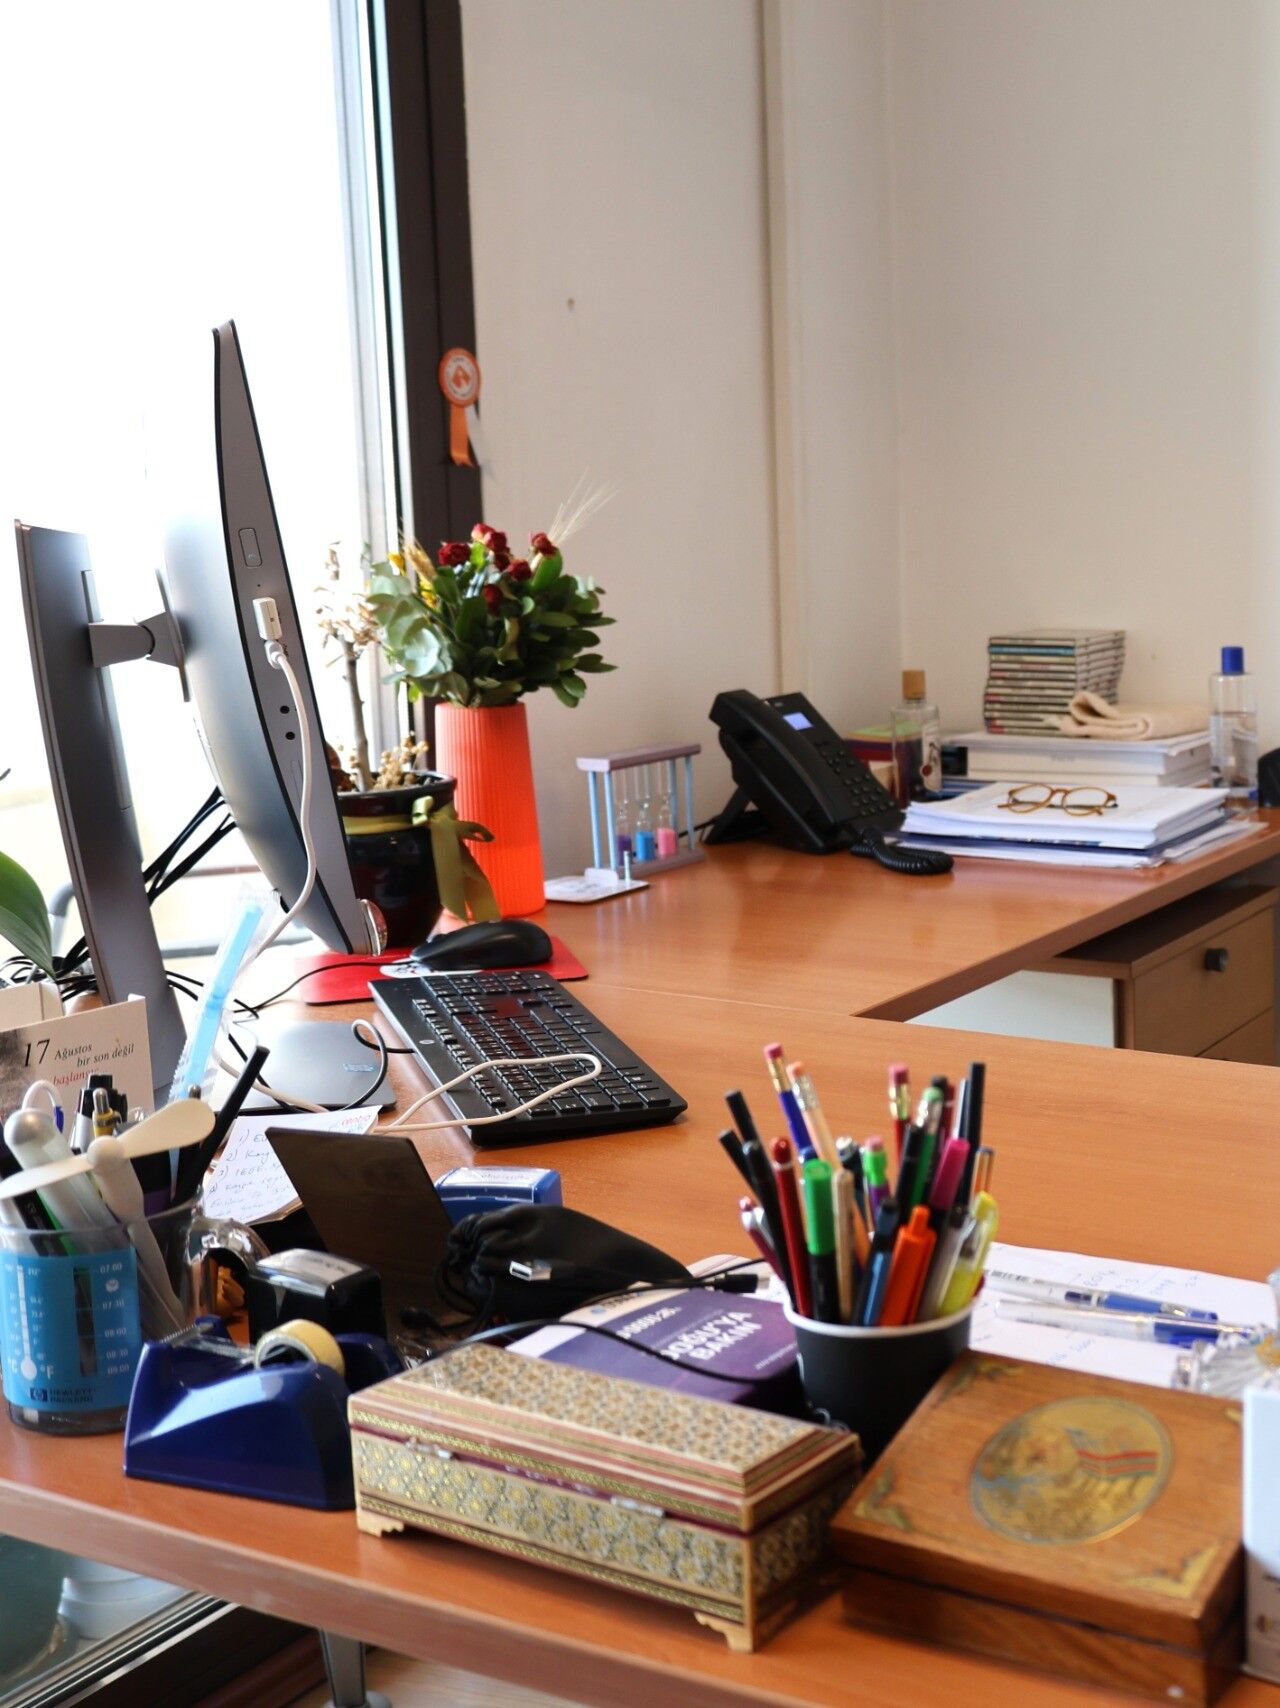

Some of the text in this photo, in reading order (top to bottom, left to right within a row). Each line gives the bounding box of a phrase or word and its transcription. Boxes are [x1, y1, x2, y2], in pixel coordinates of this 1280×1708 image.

[24, 1038, 93, 1067] 17 Ağustos
[76, 1043, 135, 1068] bir son değil
